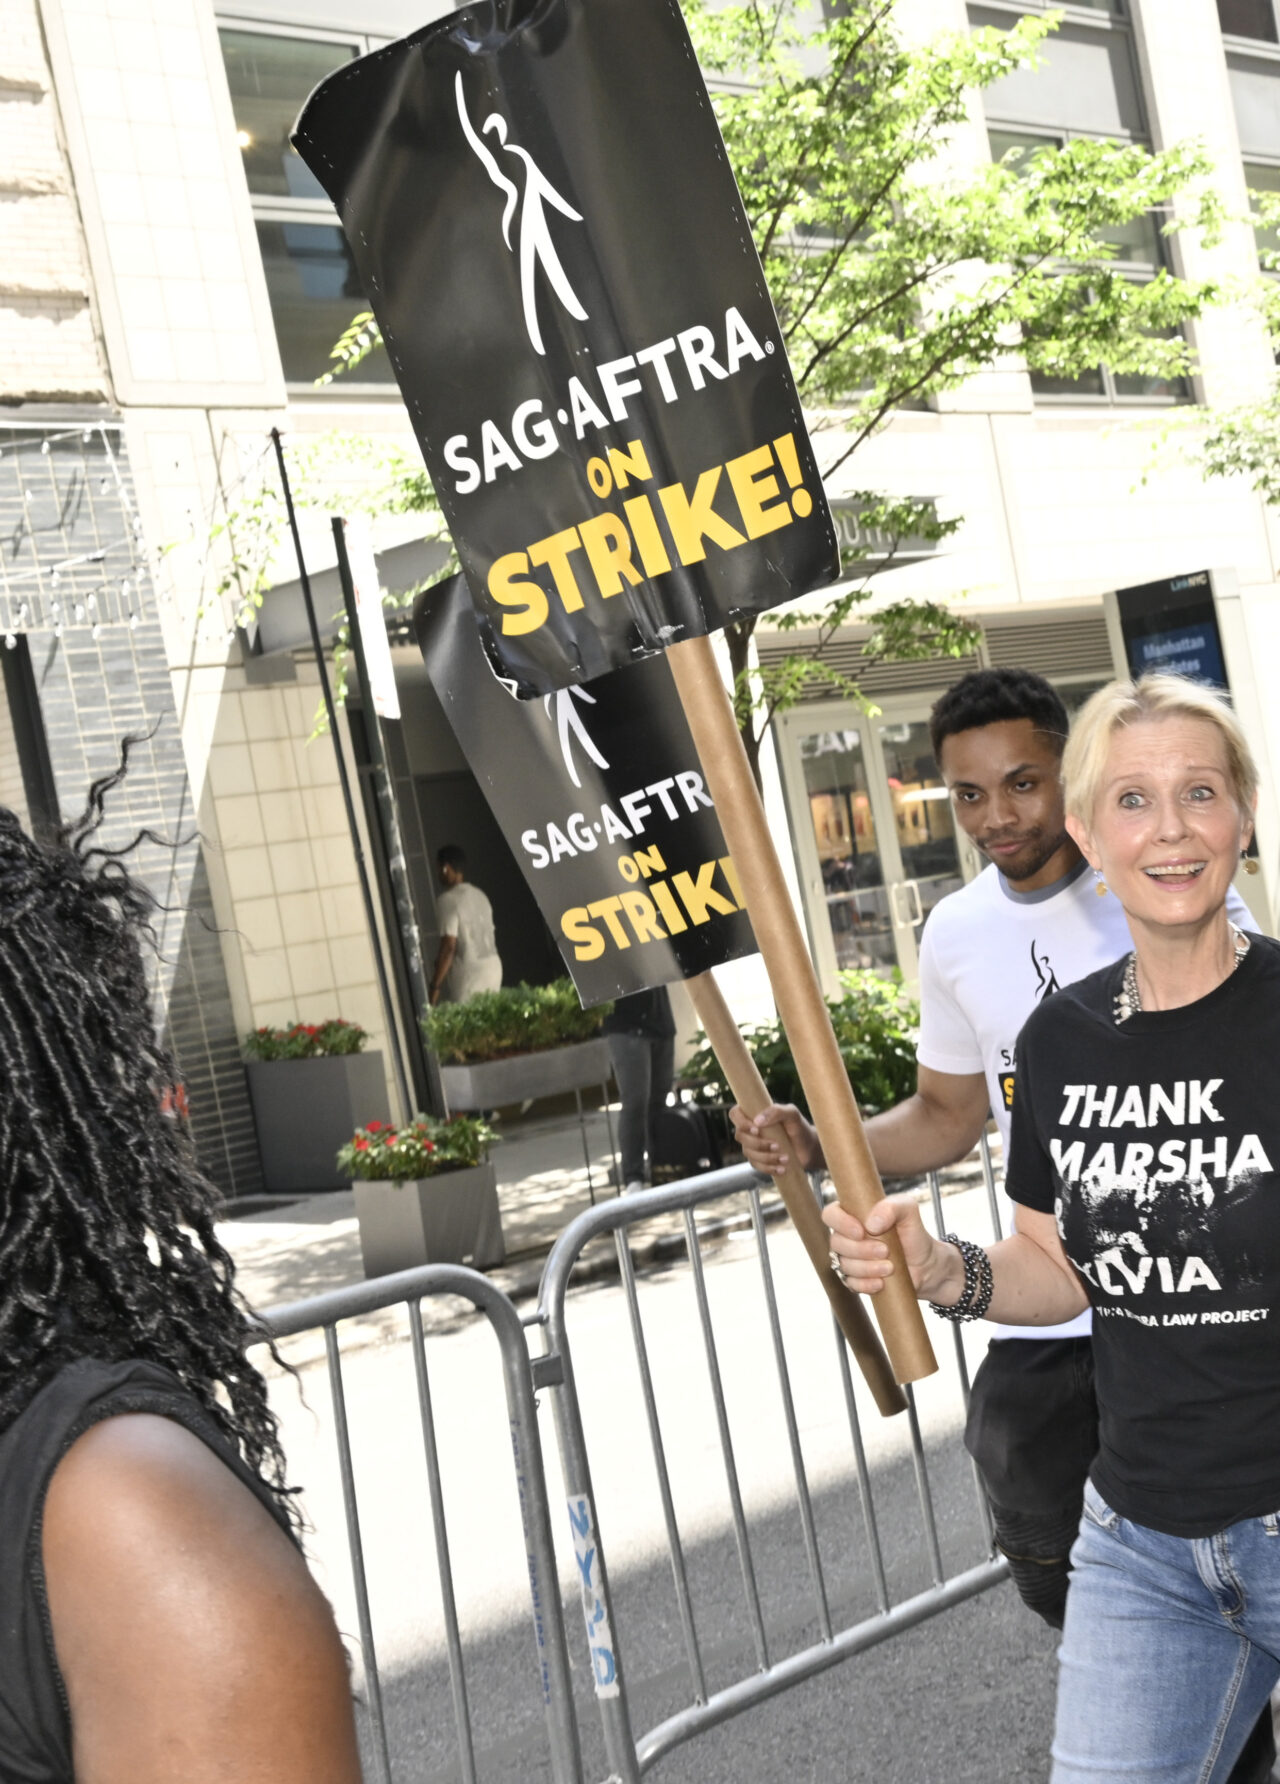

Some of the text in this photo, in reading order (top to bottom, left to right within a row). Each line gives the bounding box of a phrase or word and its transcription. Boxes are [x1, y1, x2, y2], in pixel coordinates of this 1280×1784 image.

[586, 439, 652, 499] ON
[487, 432, 813, 636] STRIKE!
[1143, 636, 1205, 659] Manhattan
[521, 770, 715, 869] SAG·AFTR
[618, 844, 667, 883] ON
[560, 855, 748, 961] STRIK
[1058, 1078, 1225, 1128] THANK
[1050, 1134, 1274, 1187] MARSHA
[1162, 1313, 1198, 1327] LAW
[1200, 1308, 1270, 1325] PROJECT
